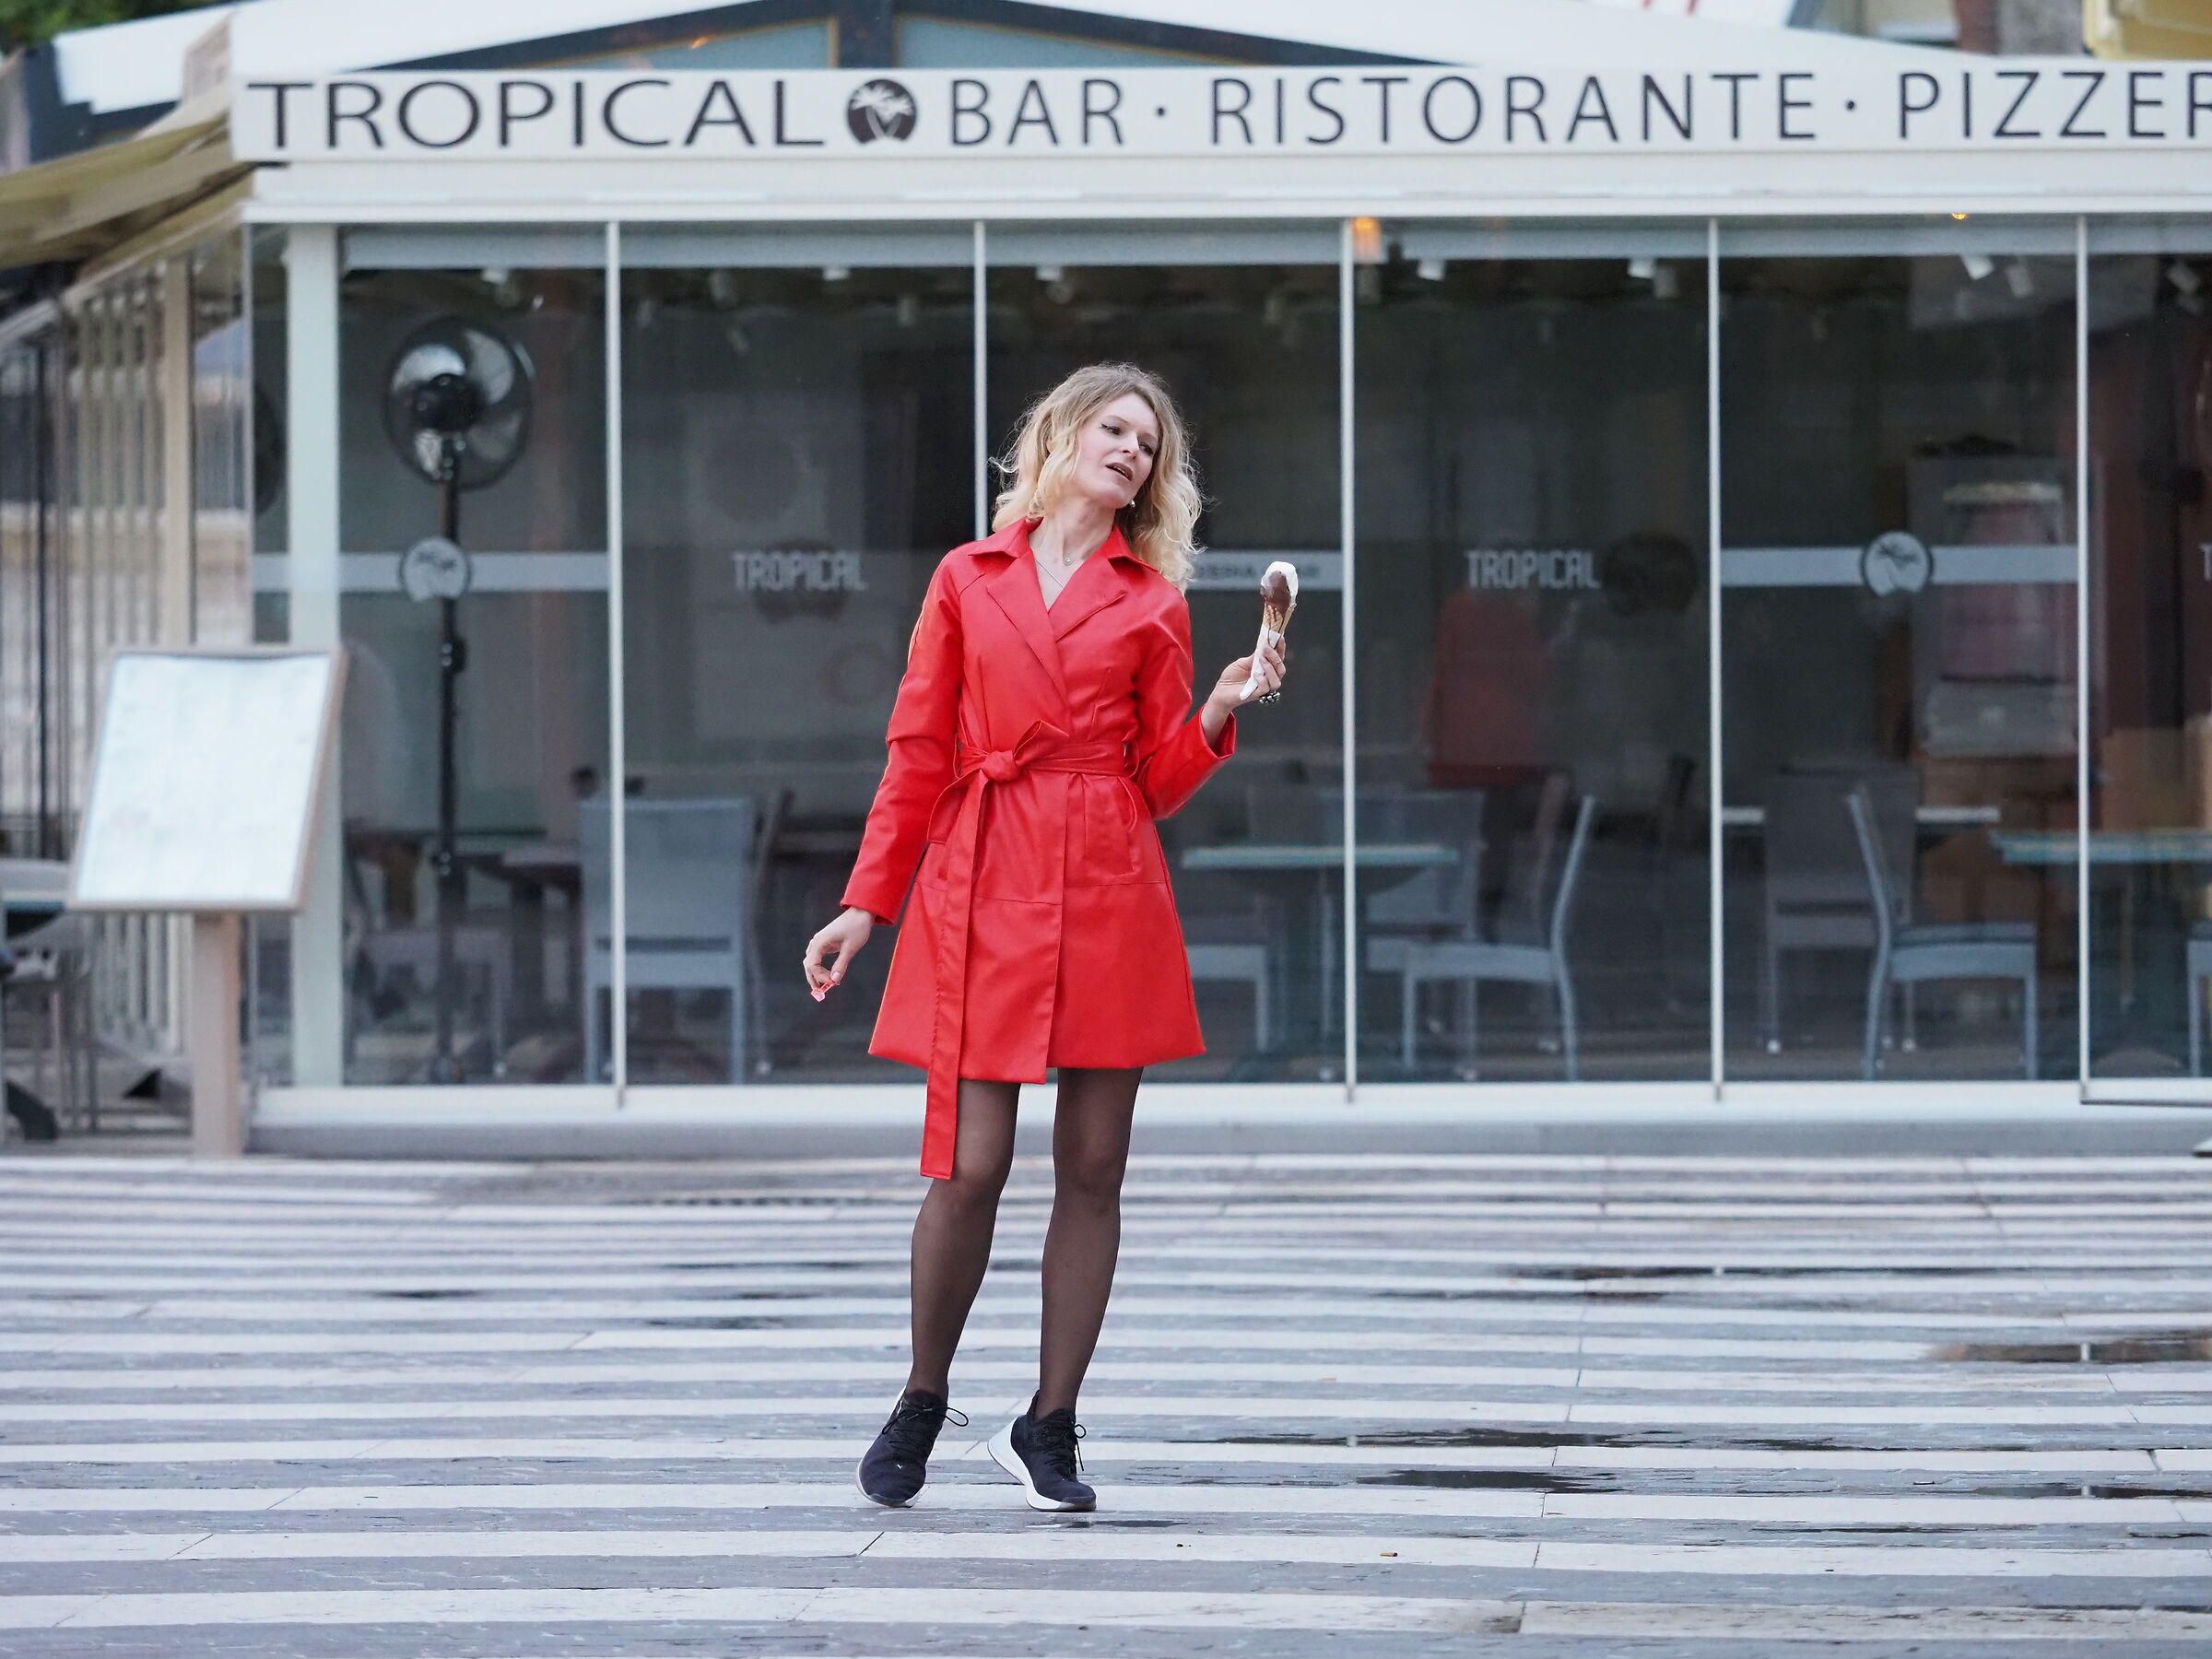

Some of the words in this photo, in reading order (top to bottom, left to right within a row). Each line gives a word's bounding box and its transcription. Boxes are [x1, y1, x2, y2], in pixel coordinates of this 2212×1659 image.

[248, 80, 823, 148] TROPICAL
[952, 79, 1122, 146] BAR
[1213, 74, 1815, 144] RISTORANTE
[1900, 72, 2212, 138] PIZZER
[733, 550, 869, 591] TROPICAL
[1465, 550, 1600, 589] TROPICAL
